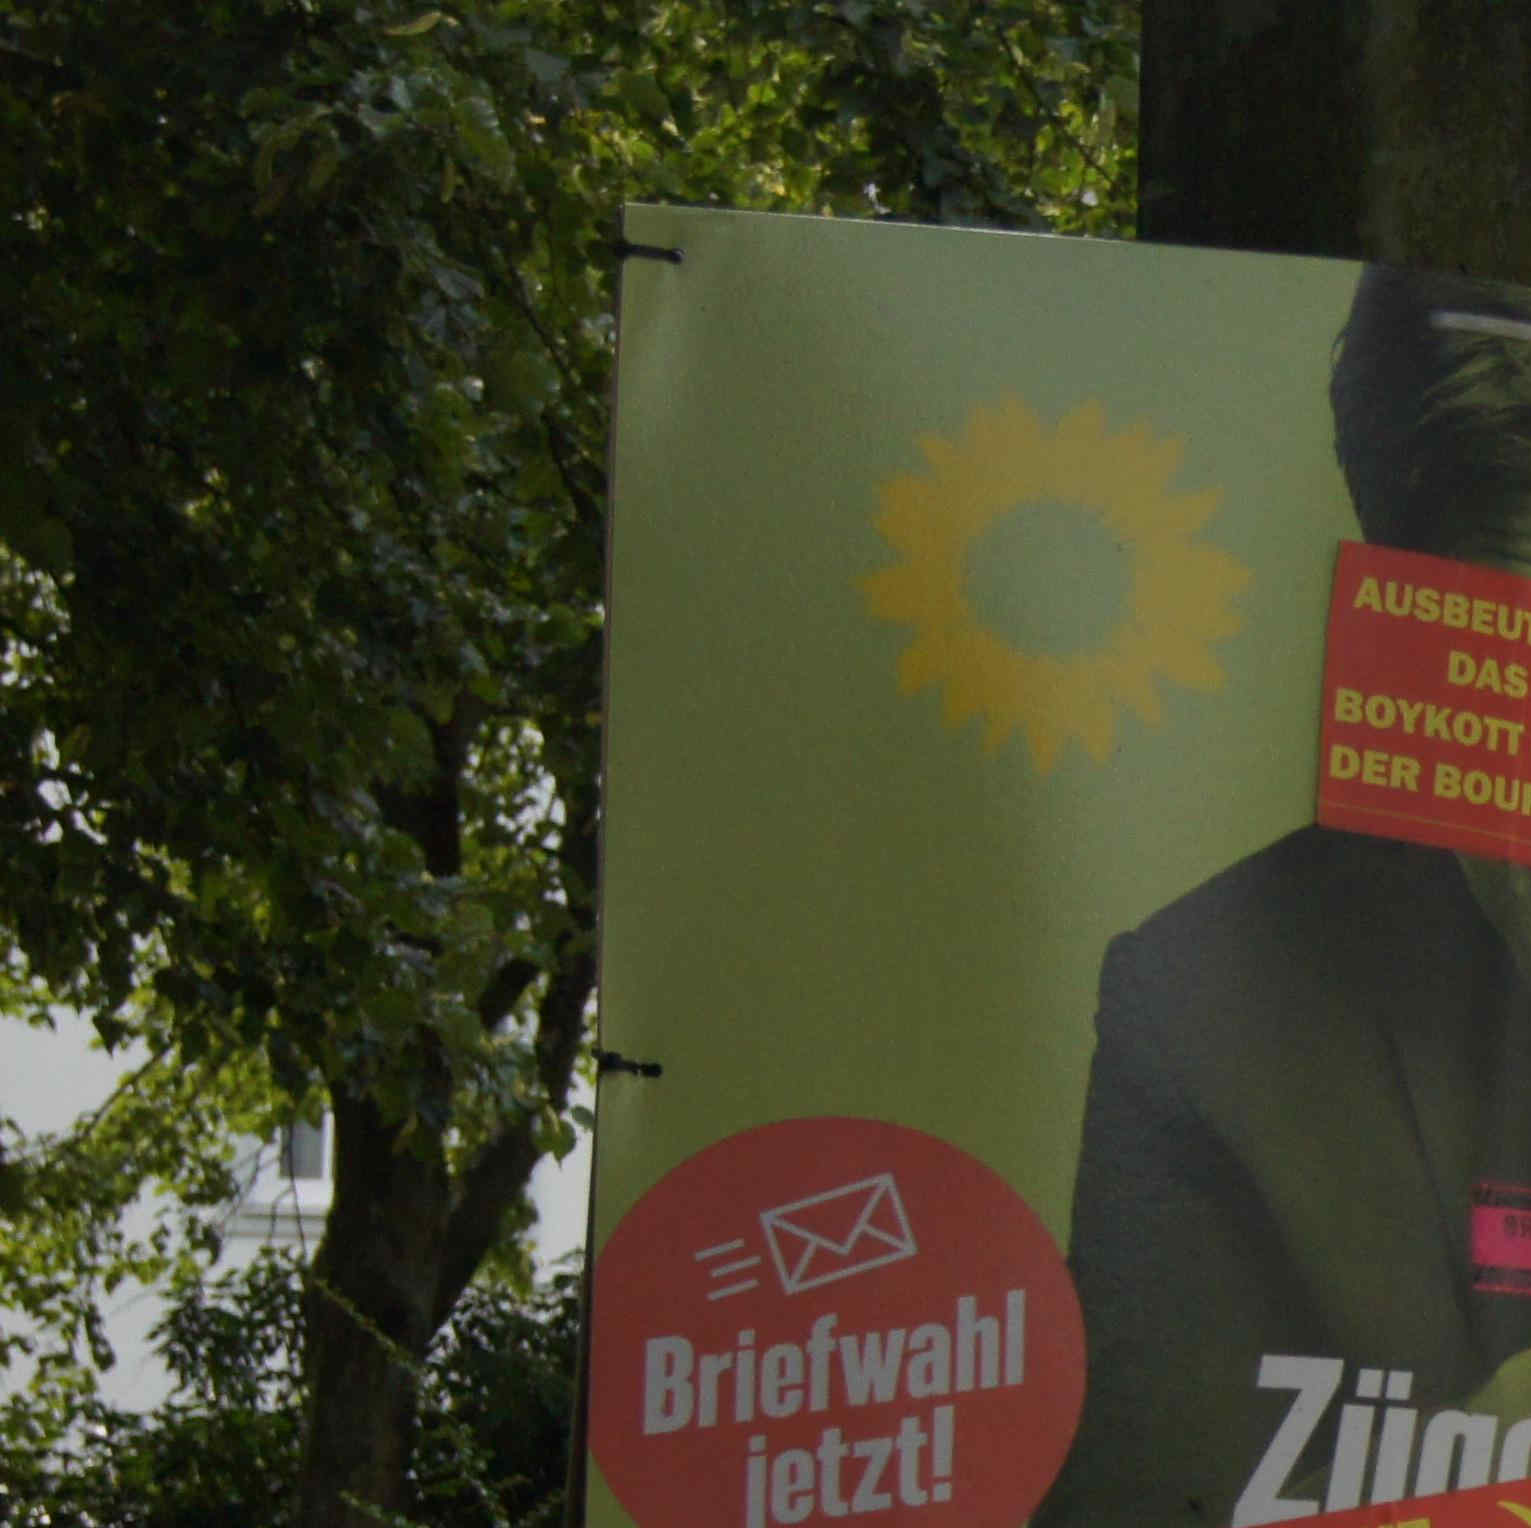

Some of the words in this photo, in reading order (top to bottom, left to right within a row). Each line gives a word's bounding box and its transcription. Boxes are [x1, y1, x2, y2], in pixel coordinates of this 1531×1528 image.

[1447, 649, 1528, 699] DAS
[1333, 687, 1525, 756] BOYKOTT
[1328, 743, 1421, 793] DER
[642, 1288, 1026, 1436] Briefwahl
